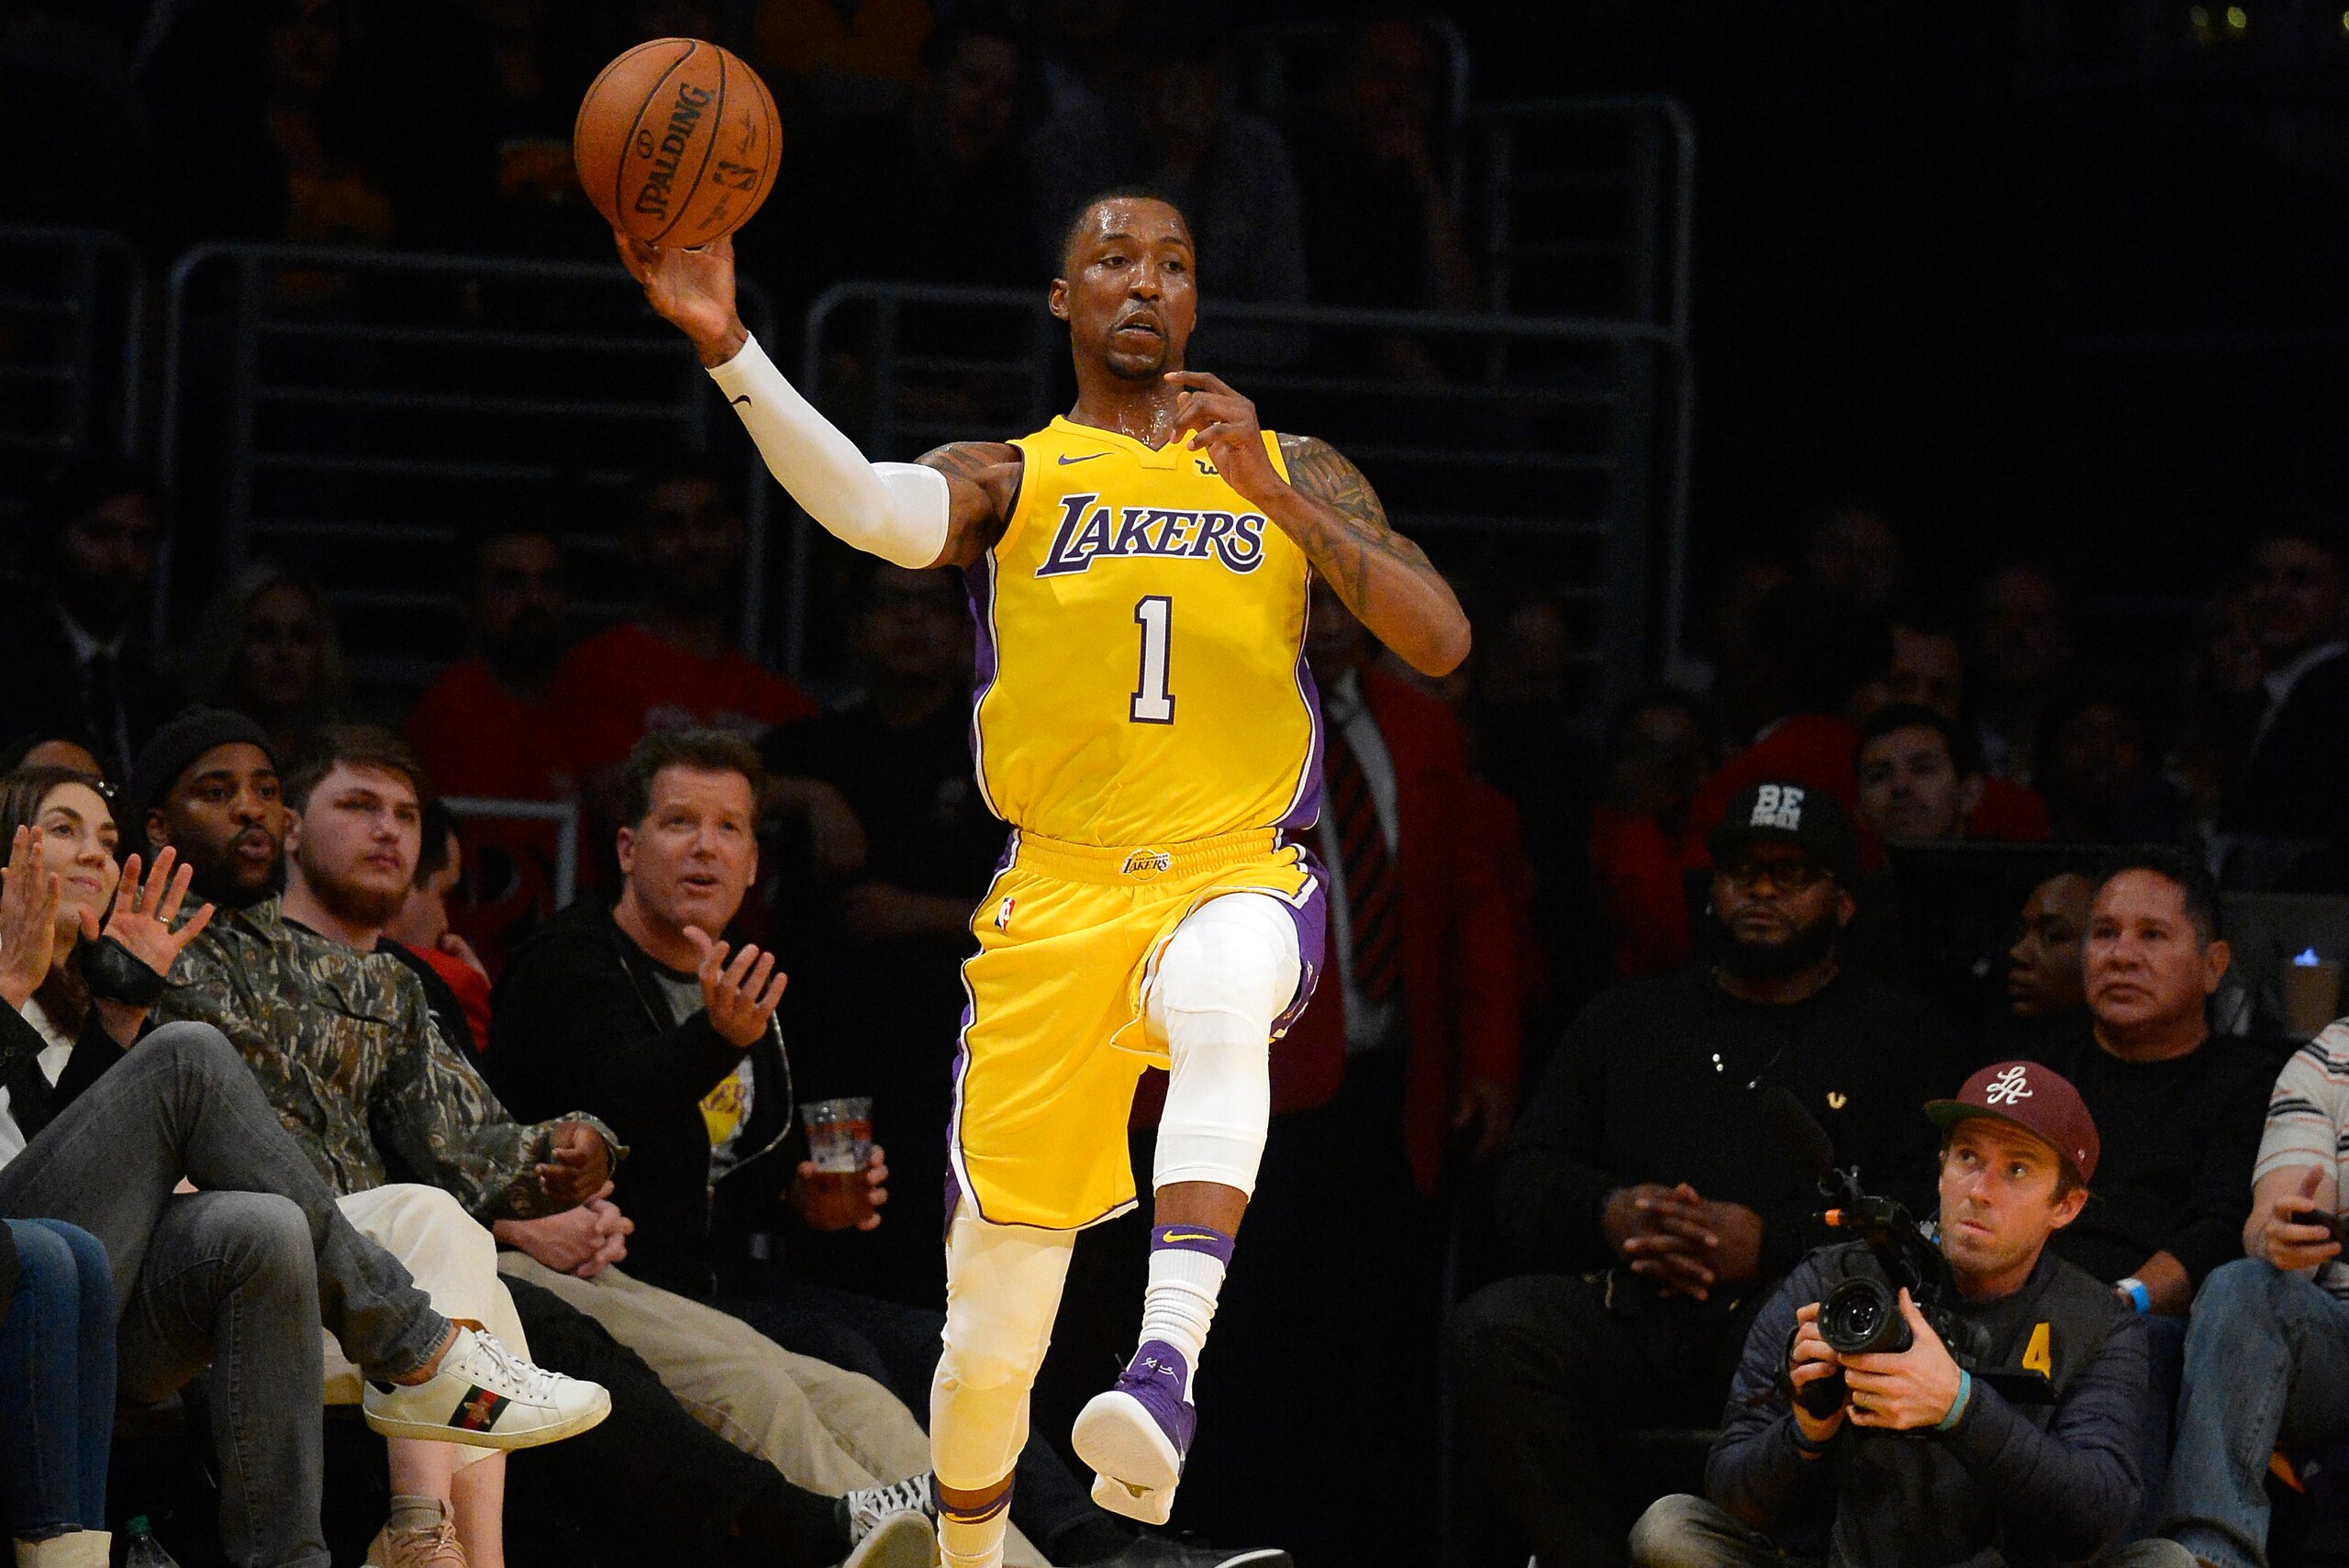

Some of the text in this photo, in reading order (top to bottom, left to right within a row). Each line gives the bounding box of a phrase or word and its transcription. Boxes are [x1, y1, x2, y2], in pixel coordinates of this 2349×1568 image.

[633, 82, 714, 222] SPALDING
[1034, 492, 1269, 579] LAKERS
[1129, 595, 1176, 725] 1
[1755, 784, 1805, 814] BE
[1986, 1065, 2033, 1106] LA
